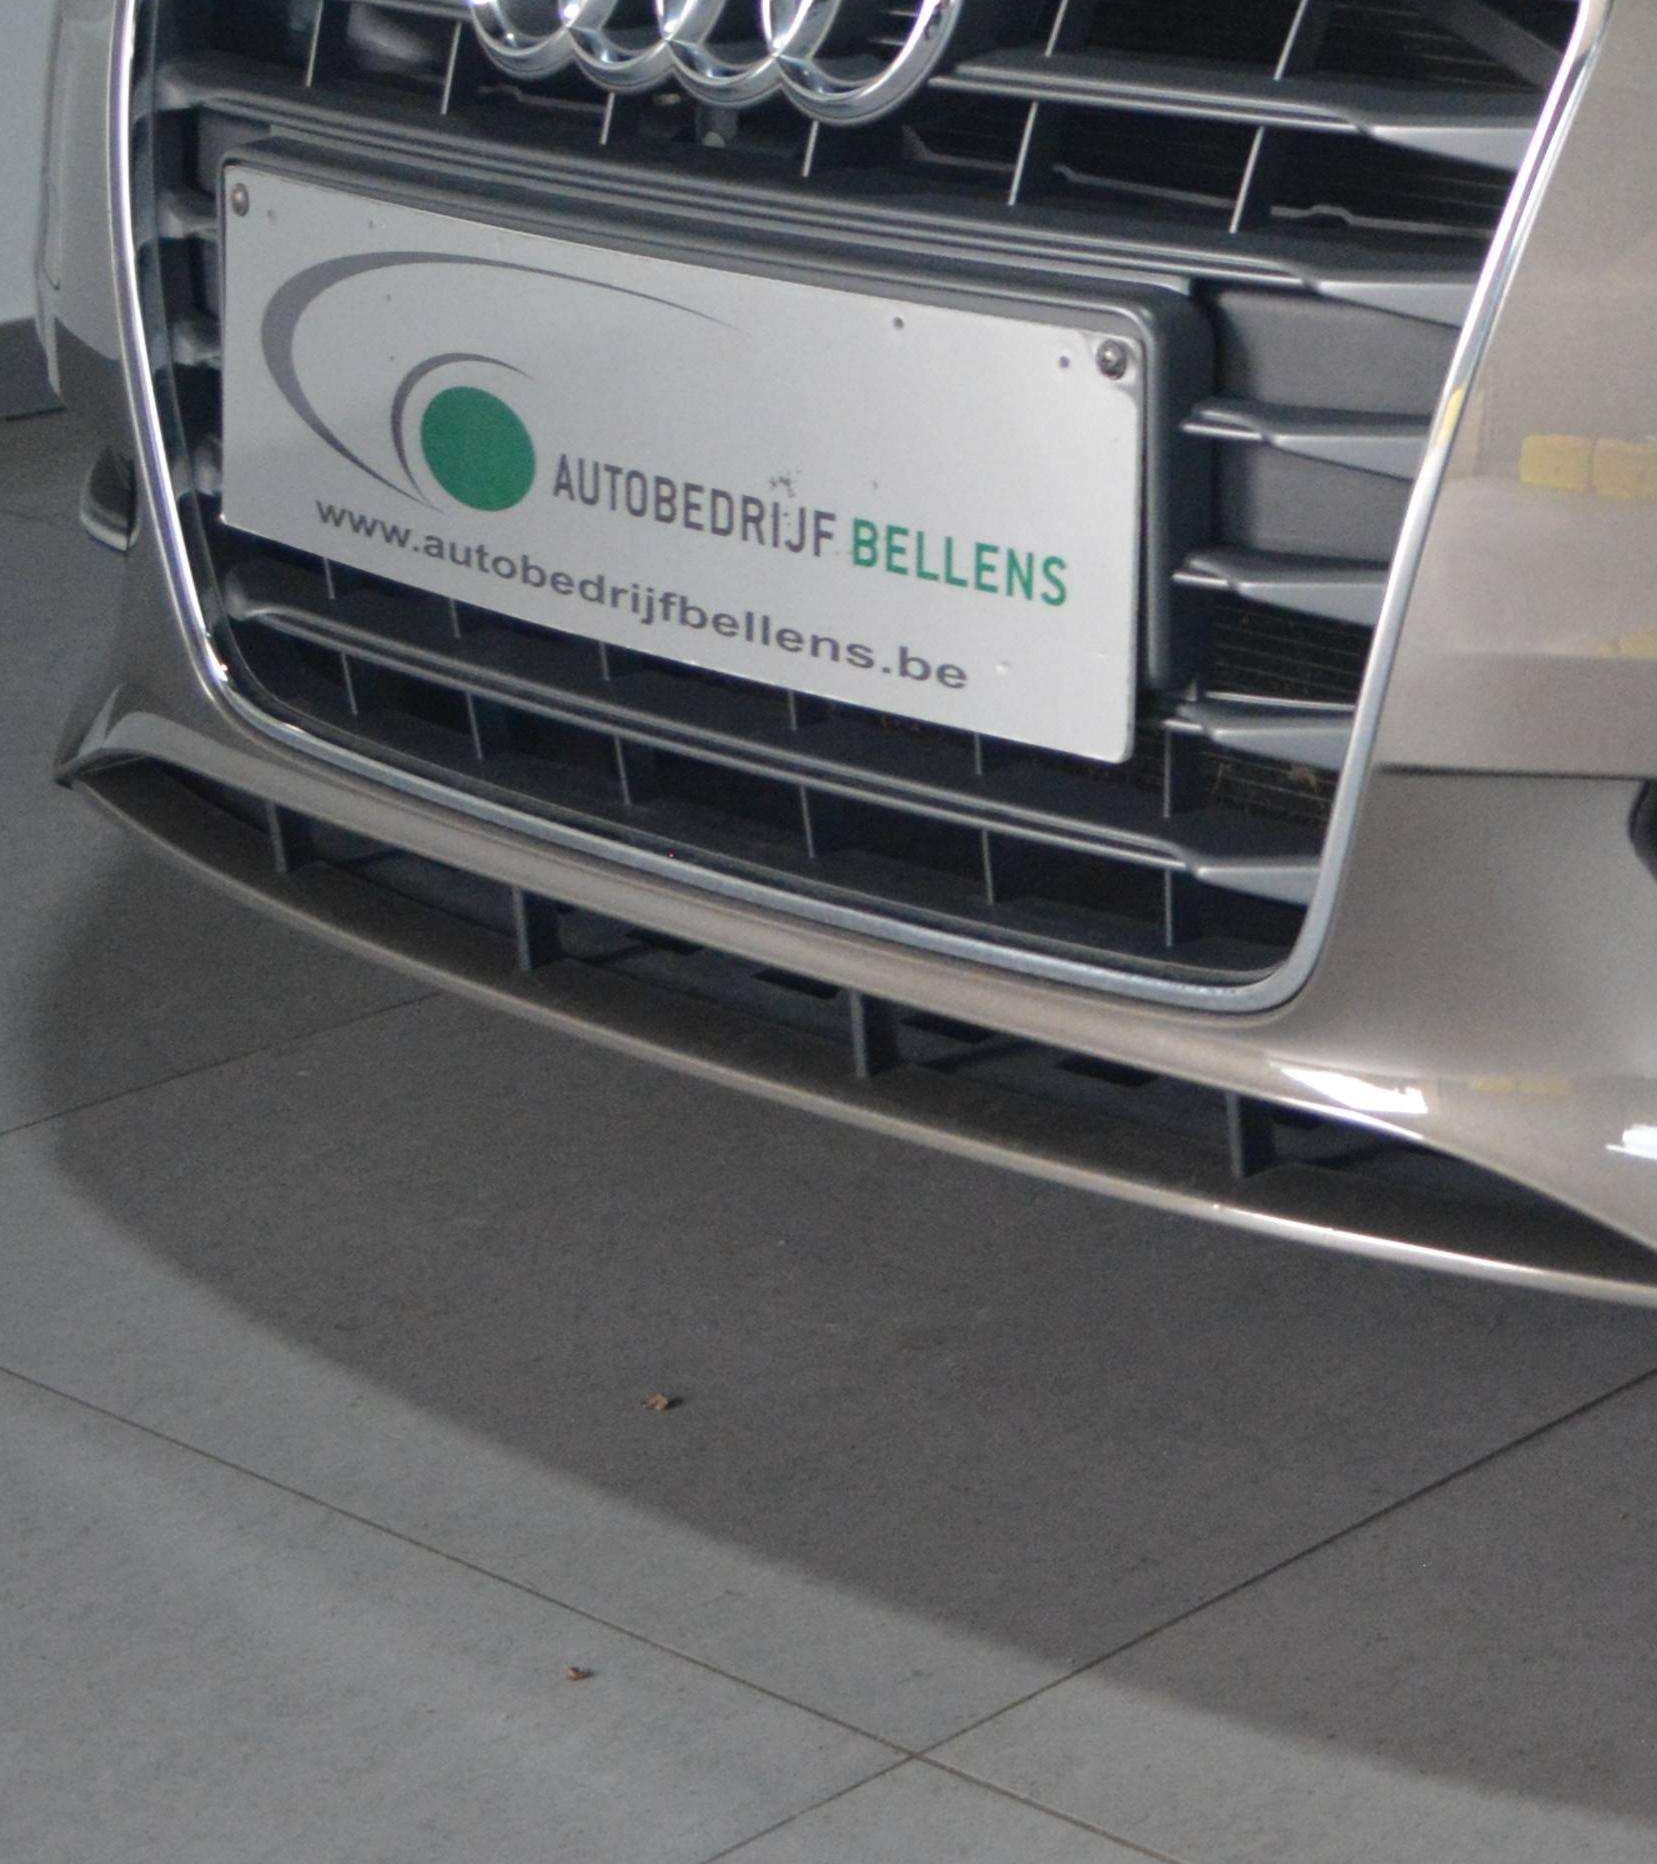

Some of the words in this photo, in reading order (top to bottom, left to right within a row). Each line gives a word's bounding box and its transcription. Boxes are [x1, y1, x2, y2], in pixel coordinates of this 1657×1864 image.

[315, 499, 968, 690] www.autobedrijfbellens.be
[553, 453, 837, 558] AUTOBEDRIJF
[852, 518, 1068, 607] BELLENS
